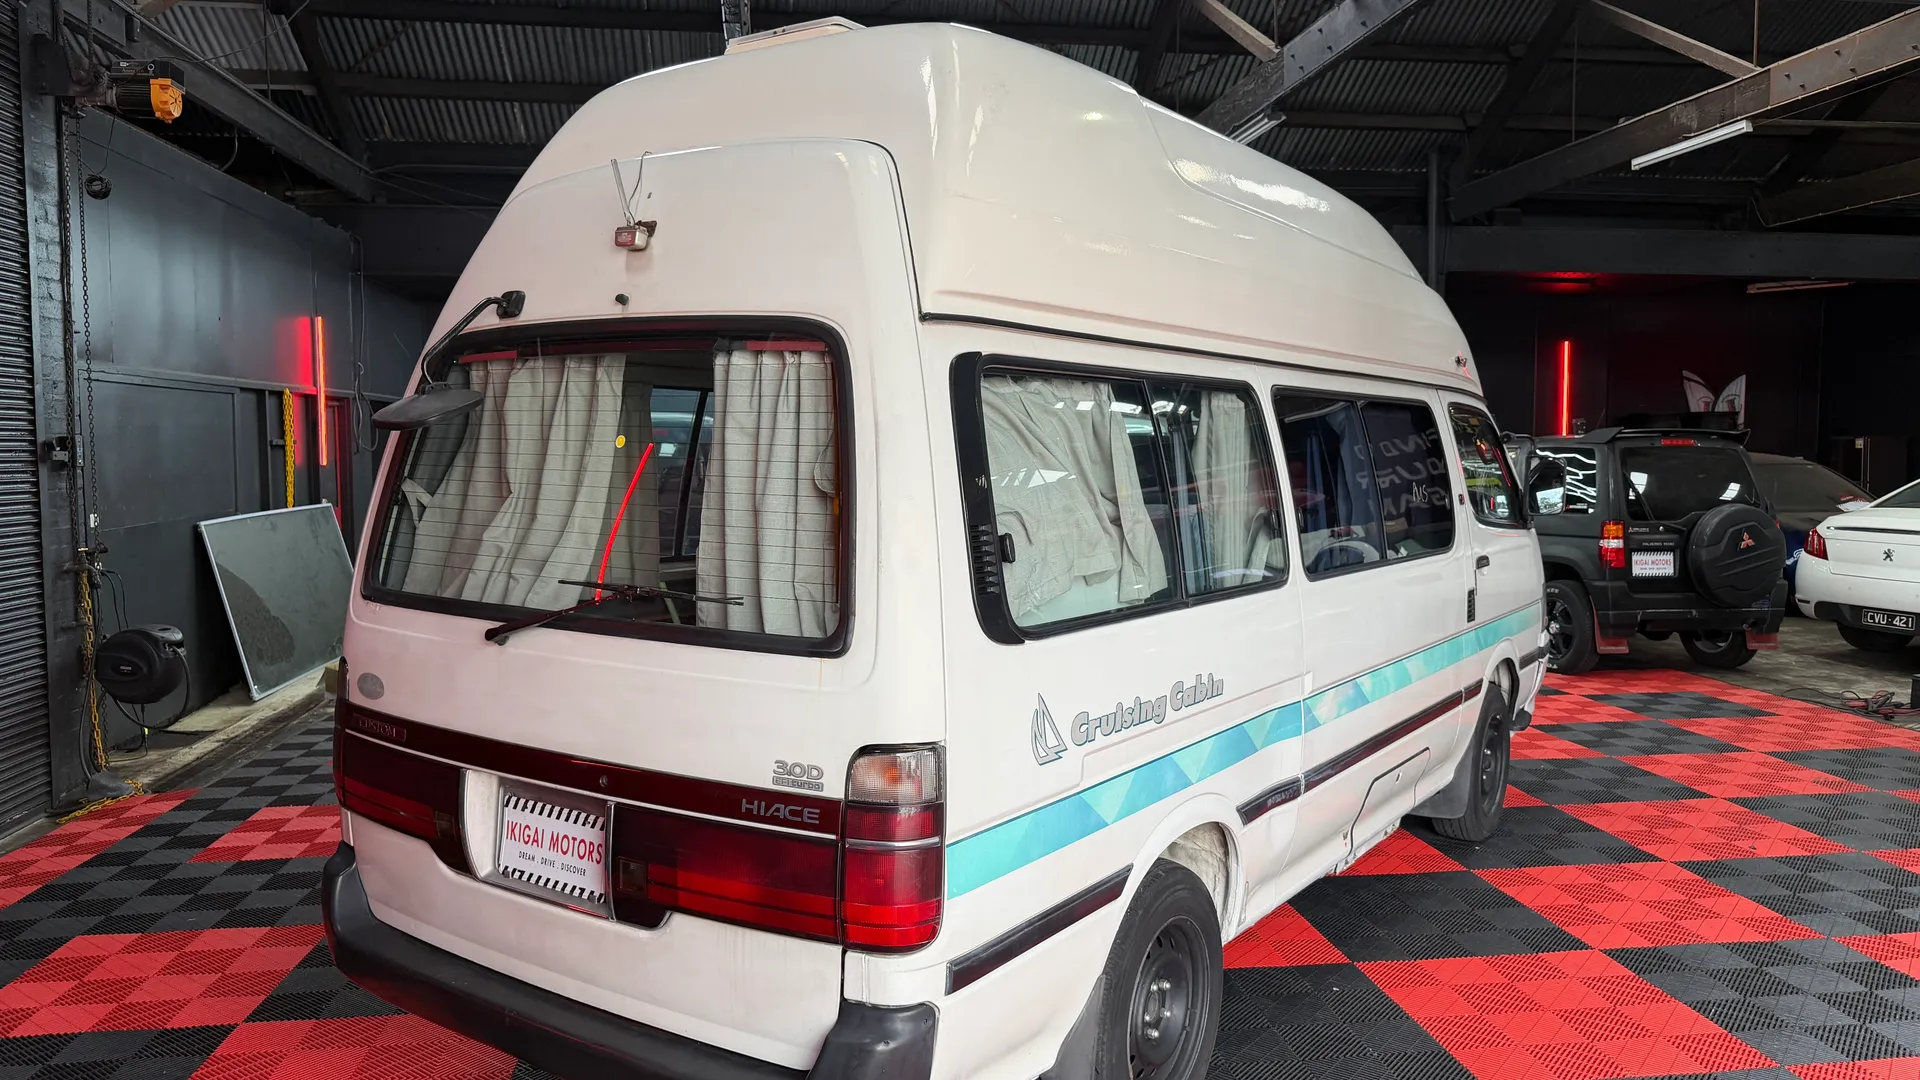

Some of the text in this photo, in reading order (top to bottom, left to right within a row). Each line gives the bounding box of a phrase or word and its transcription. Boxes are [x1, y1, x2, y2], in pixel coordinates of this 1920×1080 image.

[1070, 673, 1224, 746] Cruising Cabin
[359, 719, 396, 738] CUSTOM
[772, 759, 824, 780] 3.0D
[741, 798, 820, 824] HIACE
[505, 819, 604, 865] IKIGAI MOTORS
[518, 850, 587, 877] DREAM DRIVE DISCOVER
